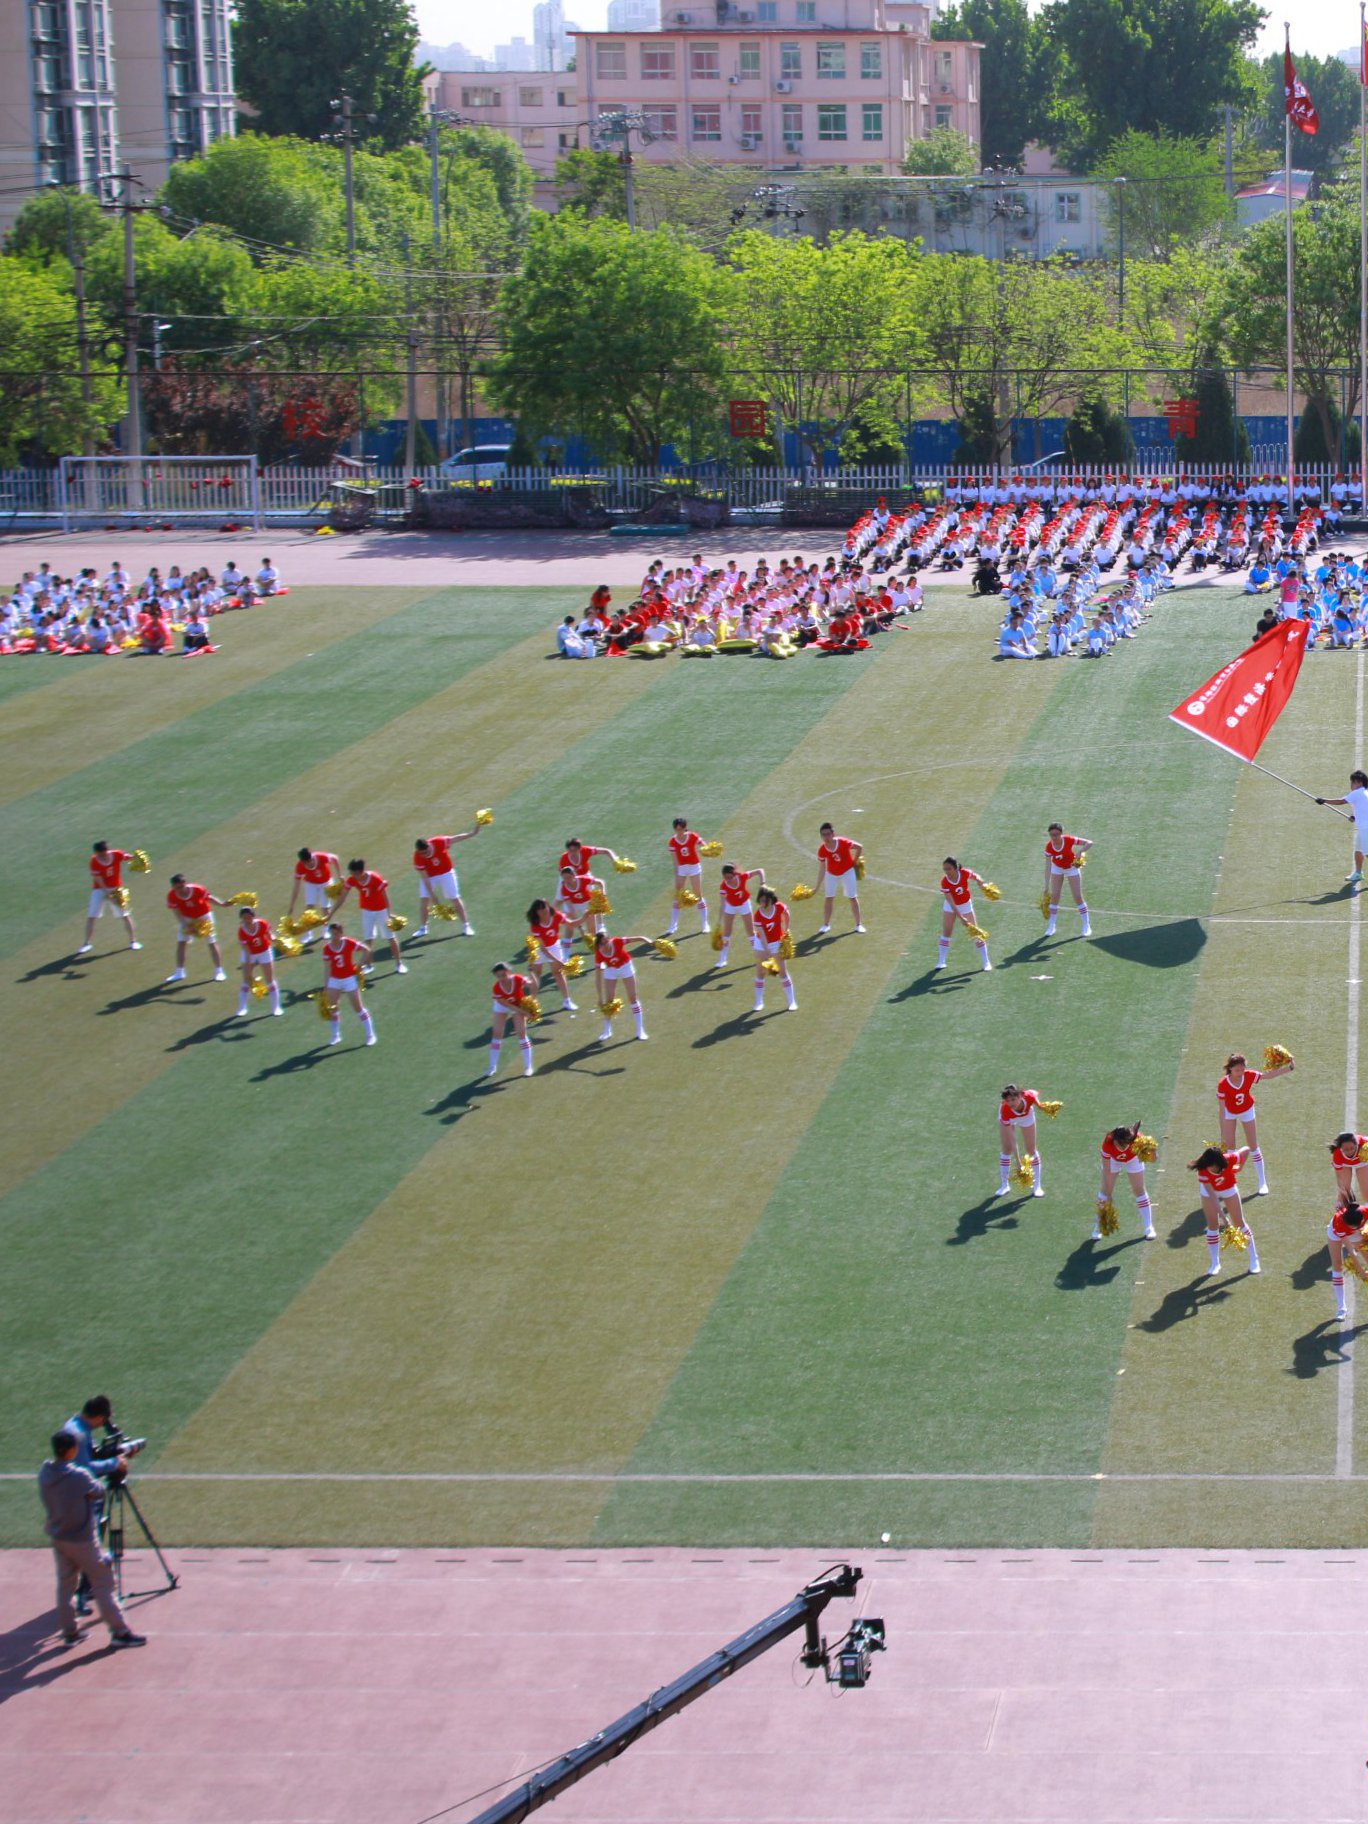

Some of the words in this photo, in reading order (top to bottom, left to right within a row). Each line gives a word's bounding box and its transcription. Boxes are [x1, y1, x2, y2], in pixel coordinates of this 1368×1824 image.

[282, 397, 328, 441] 校
[729, 400, 766, 436] 园
[1163, 397, 1201, 440] 青
[766, 922, 775, 932] 7
[334, 955, 344, 968] 3
[1235, 1093, 1245, 1106] 3
[1214, 1176, 1225, 1187] 2
